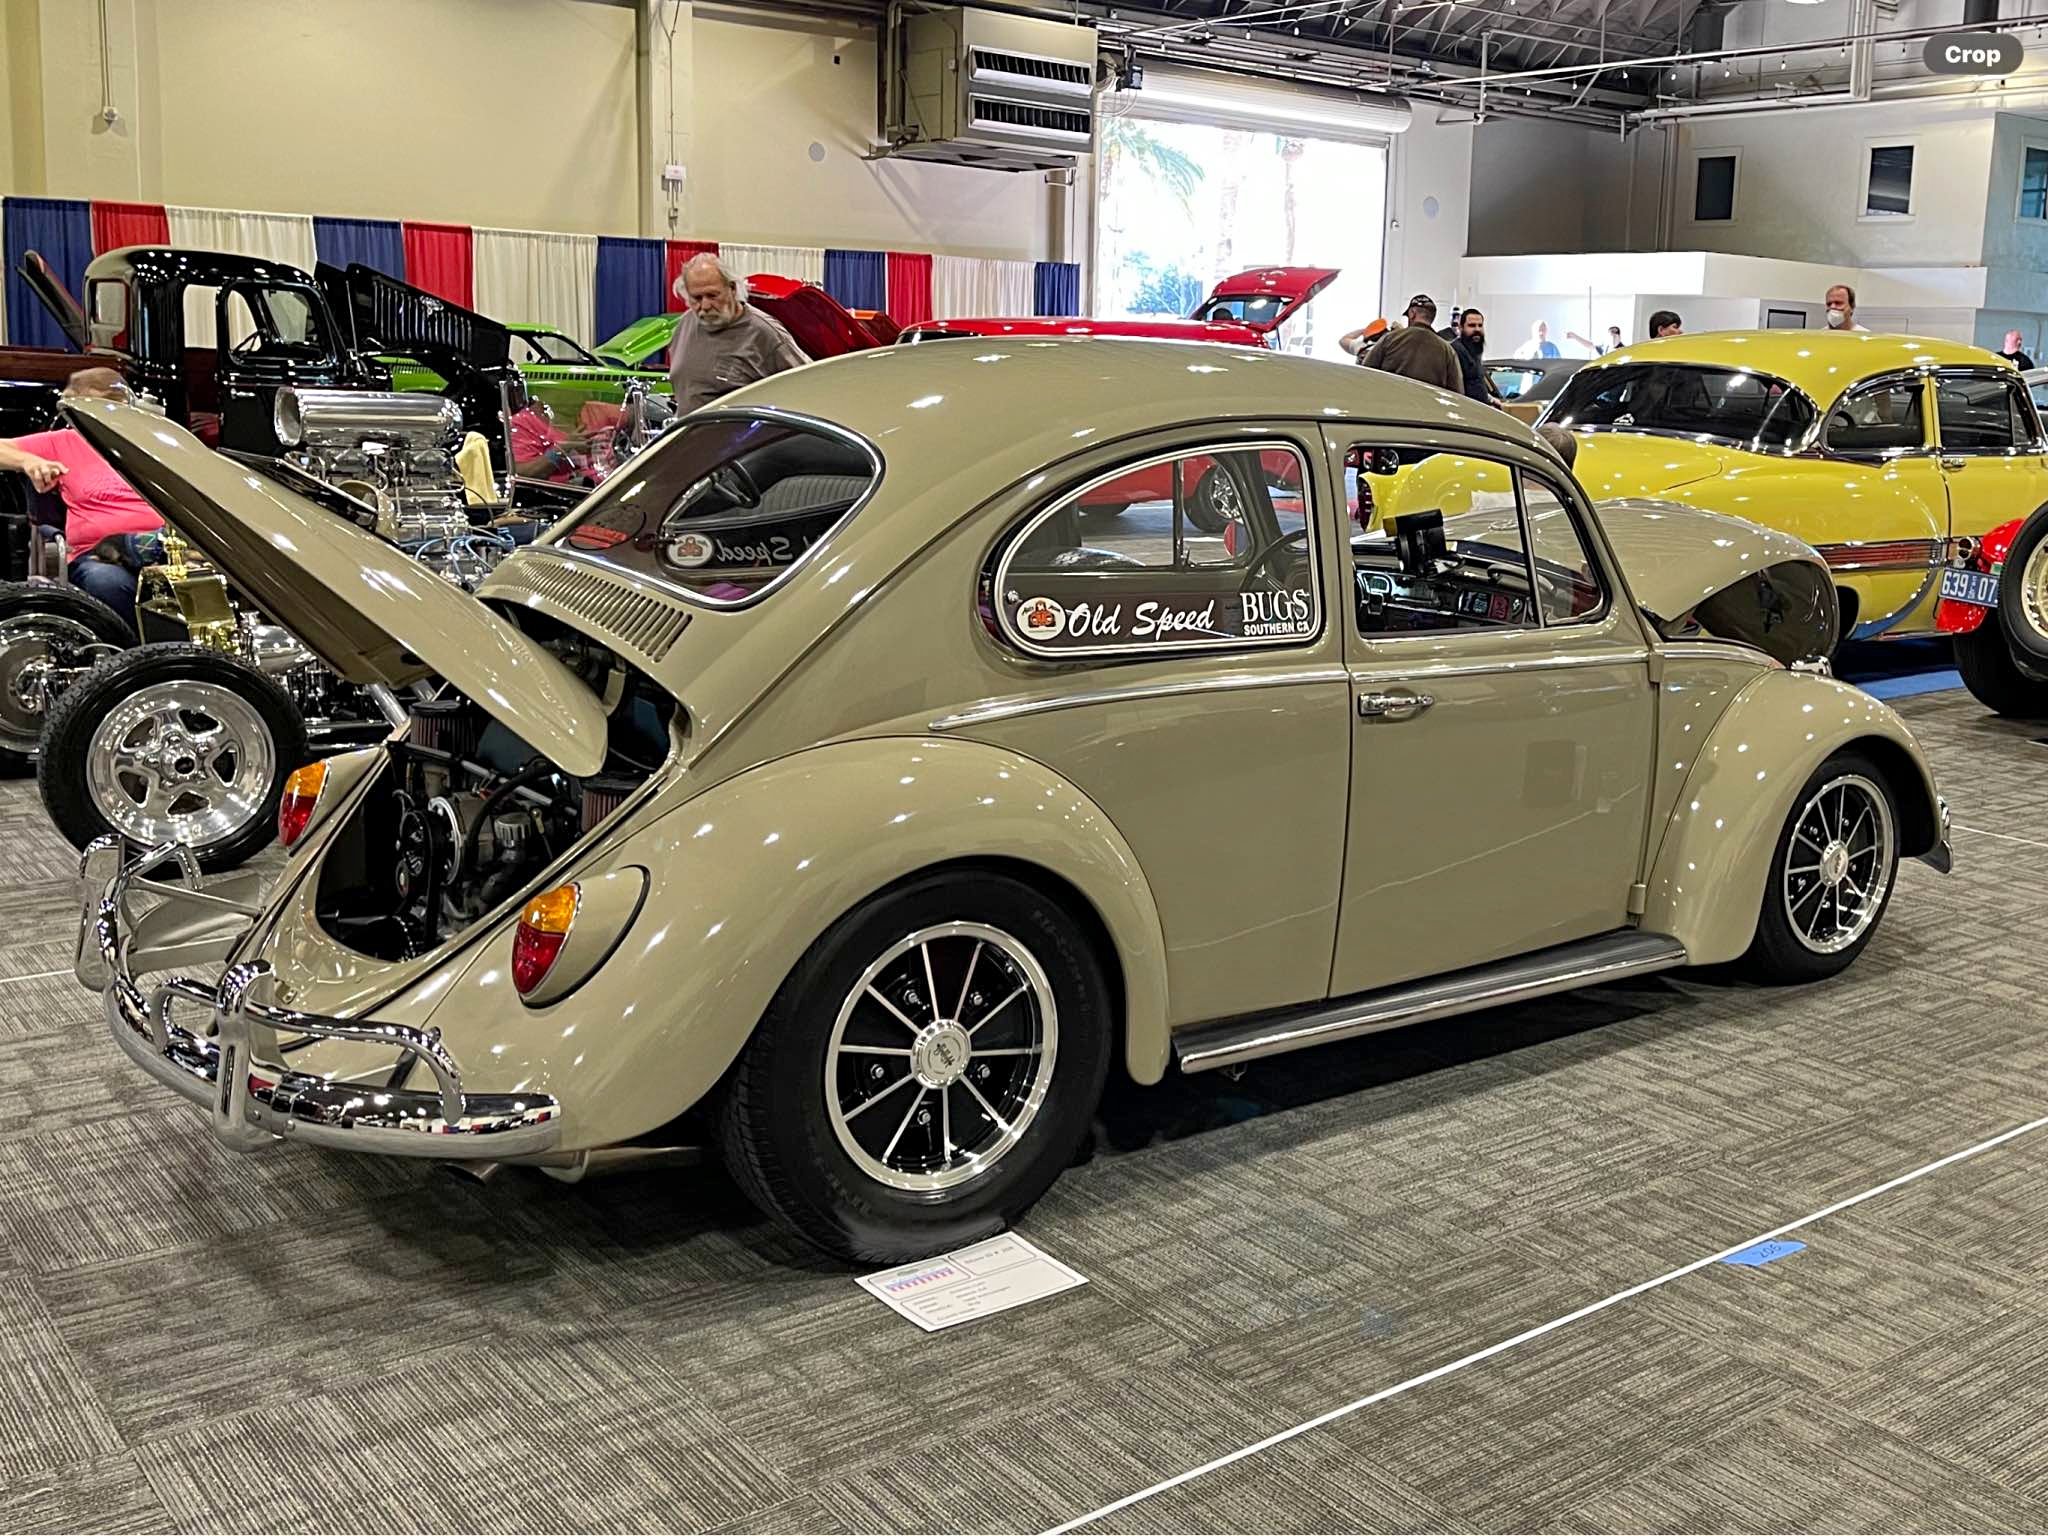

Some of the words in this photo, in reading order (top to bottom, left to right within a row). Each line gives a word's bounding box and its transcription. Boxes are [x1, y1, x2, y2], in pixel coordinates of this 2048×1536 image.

[1941, 571, 1969, 598] 639
[1067, 602, 1122, 637] Old
[1131, 599, 1217, 641] Speed
[1240, 589, 1310, 623] BUGS
[1243, 621, 1295, 636] SOUTHERN
[1296, 620, 1310, 632] CA
